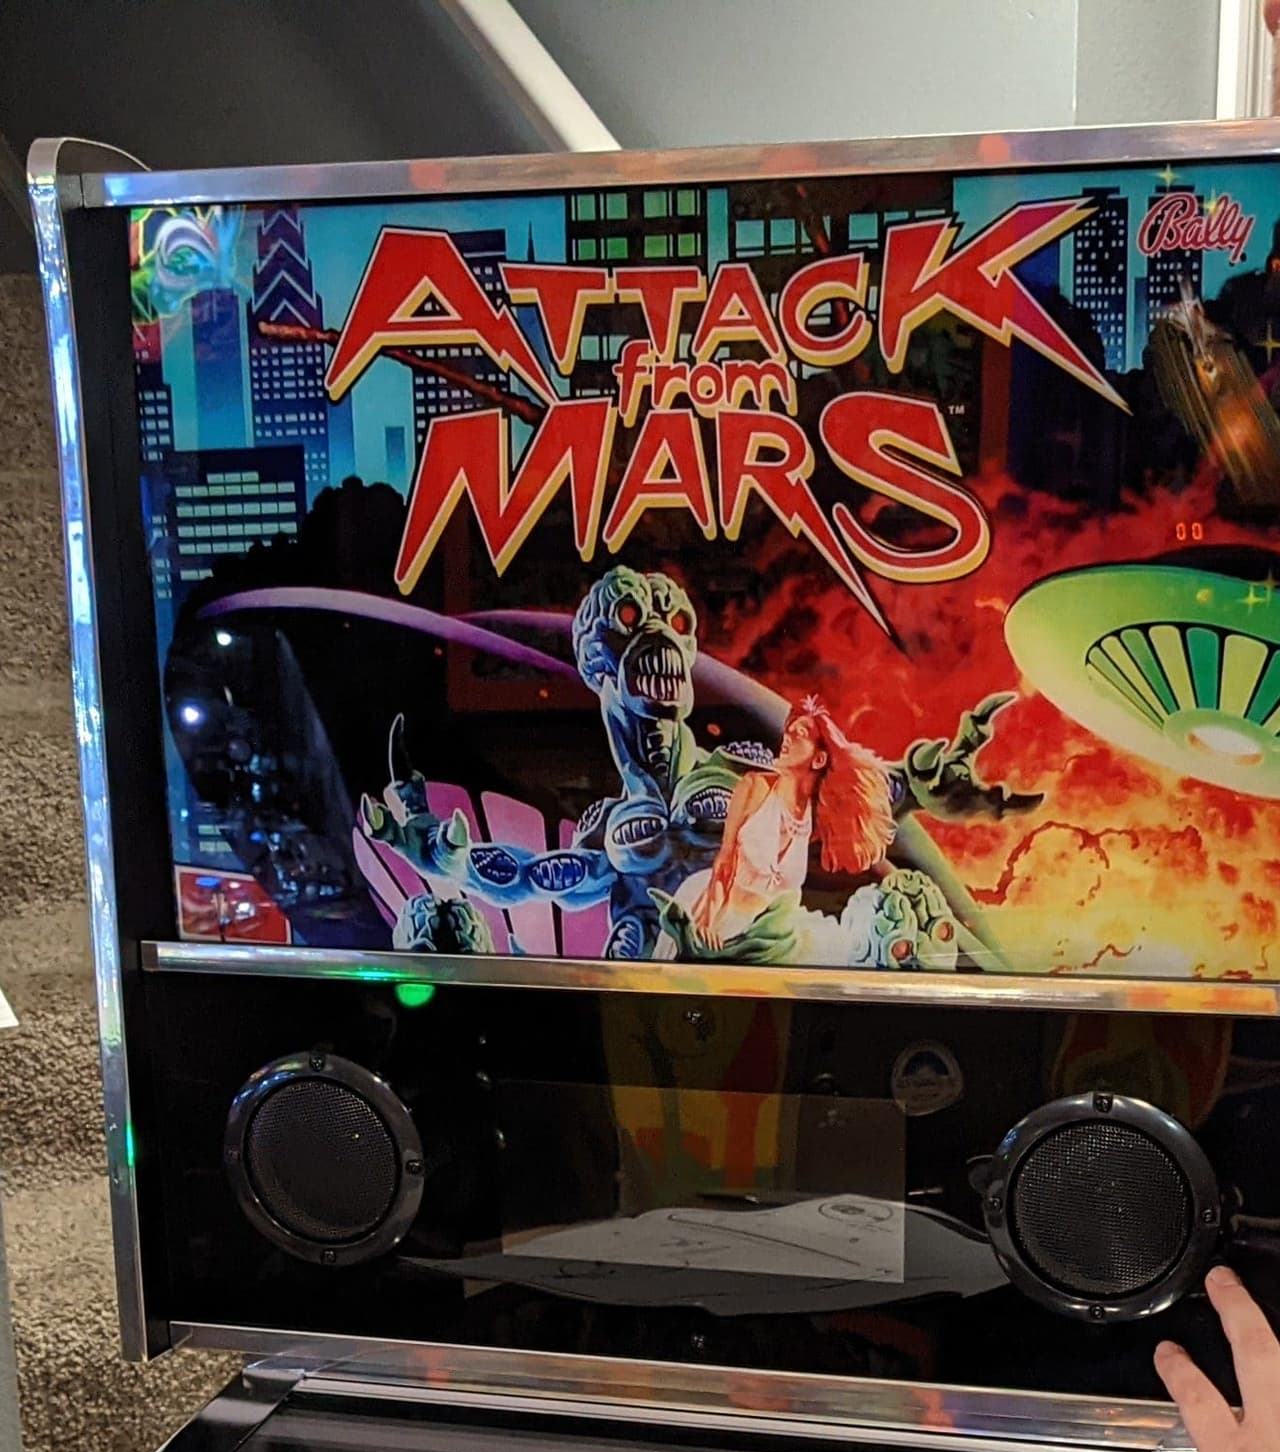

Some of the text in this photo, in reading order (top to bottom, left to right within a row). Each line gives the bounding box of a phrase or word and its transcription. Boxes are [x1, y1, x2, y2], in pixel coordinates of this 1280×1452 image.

[1137, 192, 1255, 263] Bally
[325, 196, 1133, 416] ATTACK
[613, 337, 799, 429] from
[394, 390, 992, 637] MARS
